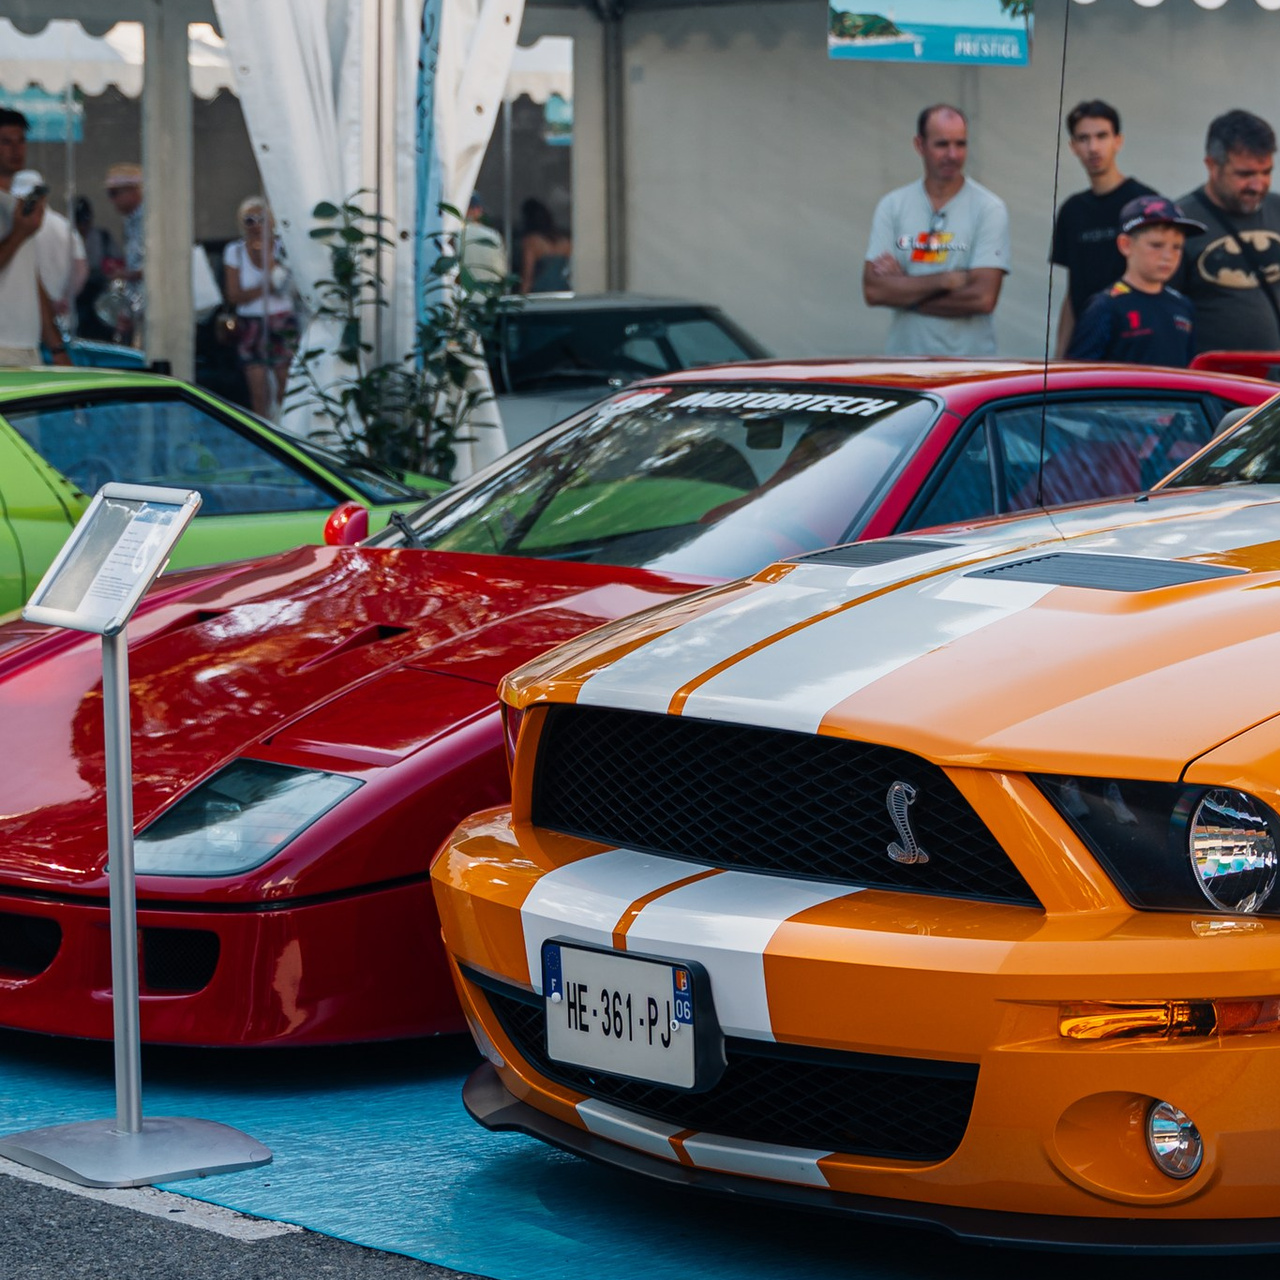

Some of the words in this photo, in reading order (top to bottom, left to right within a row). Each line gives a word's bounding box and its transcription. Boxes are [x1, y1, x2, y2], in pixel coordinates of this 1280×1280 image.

[667, 391, 899, 417] MOTORTECH
[551, 978, 557, 991] F
[566, 981, 671, 1049] HE-361-PJ
[675, 999, 691, 1020] 06
